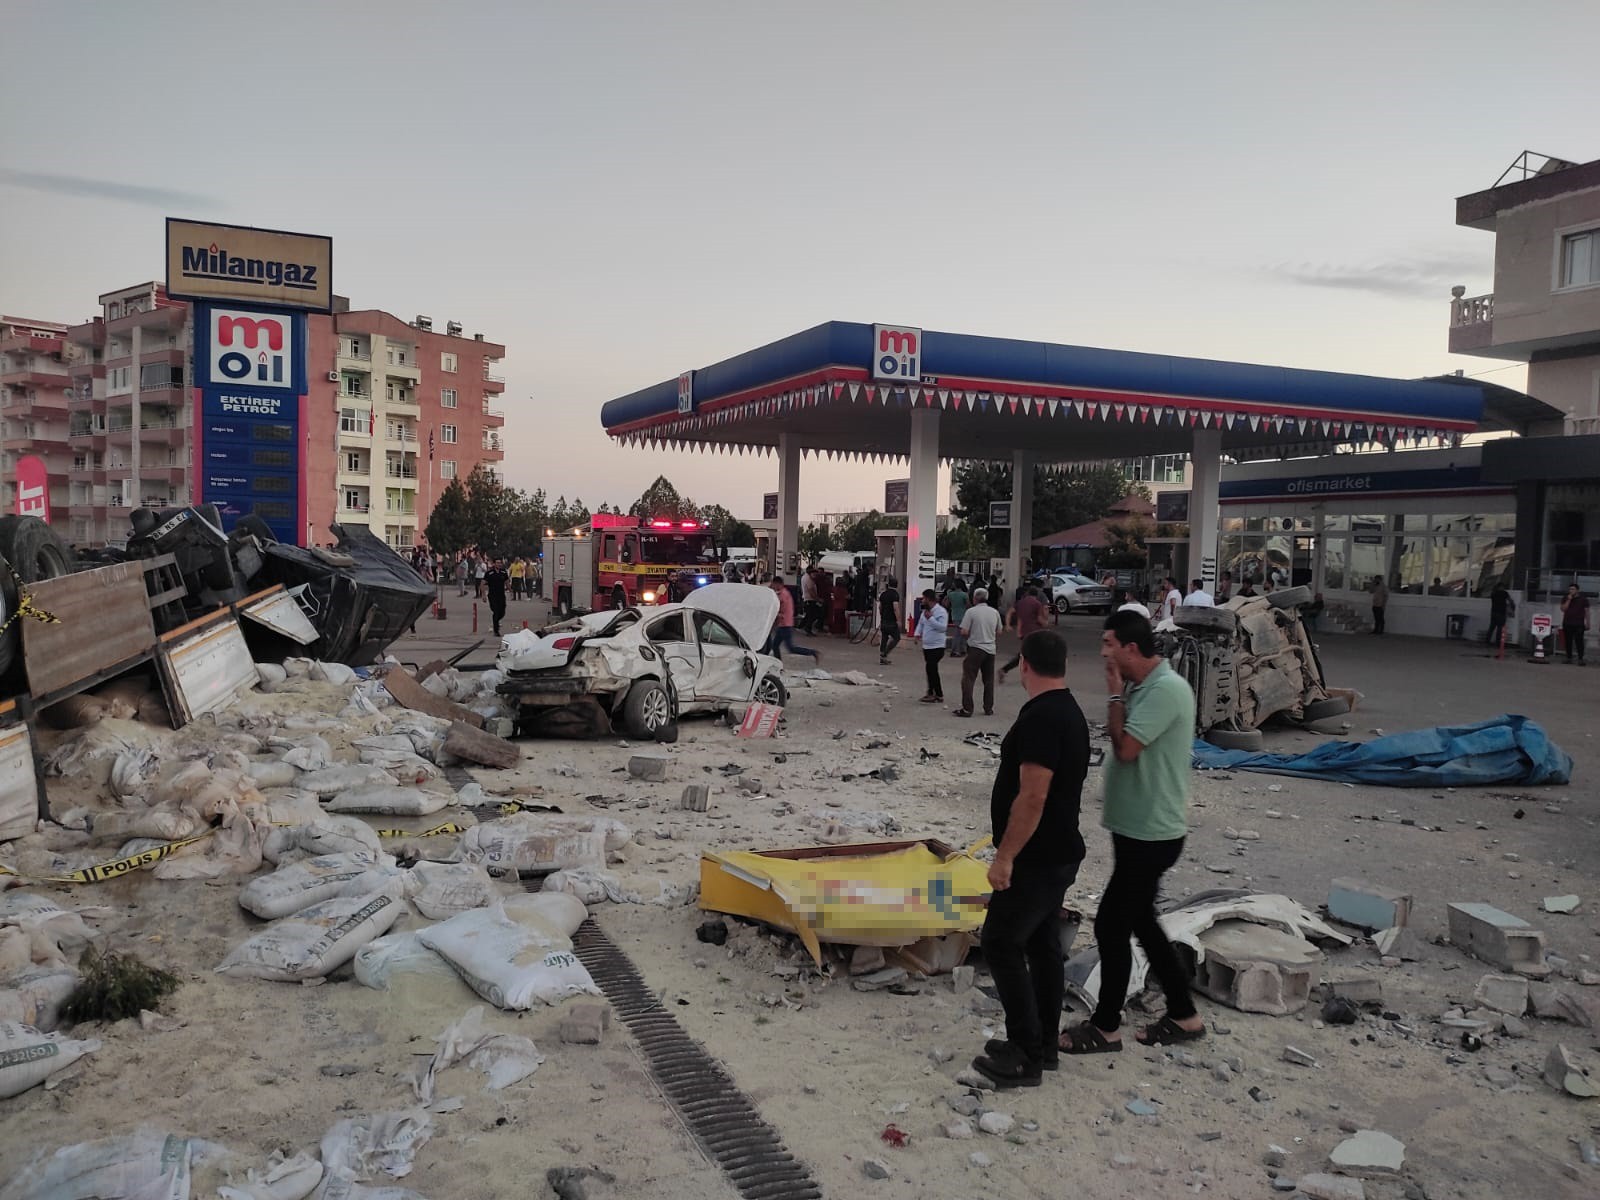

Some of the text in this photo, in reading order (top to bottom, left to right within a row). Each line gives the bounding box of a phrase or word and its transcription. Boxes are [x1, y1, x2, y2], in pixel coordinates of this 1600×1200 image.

[182, 243, 317, 287] Milangaz
[218, 315, 283, 351] m
[880, 329, 917, 355] m
[218, 351, 283, 382] oil
[880, 354, 916, 377] oil
[220, 395, 281, 407] EKTİREN
[223, 403, 279, 414] PETROL
[1287, 476, 1371, 493] ofismarket
